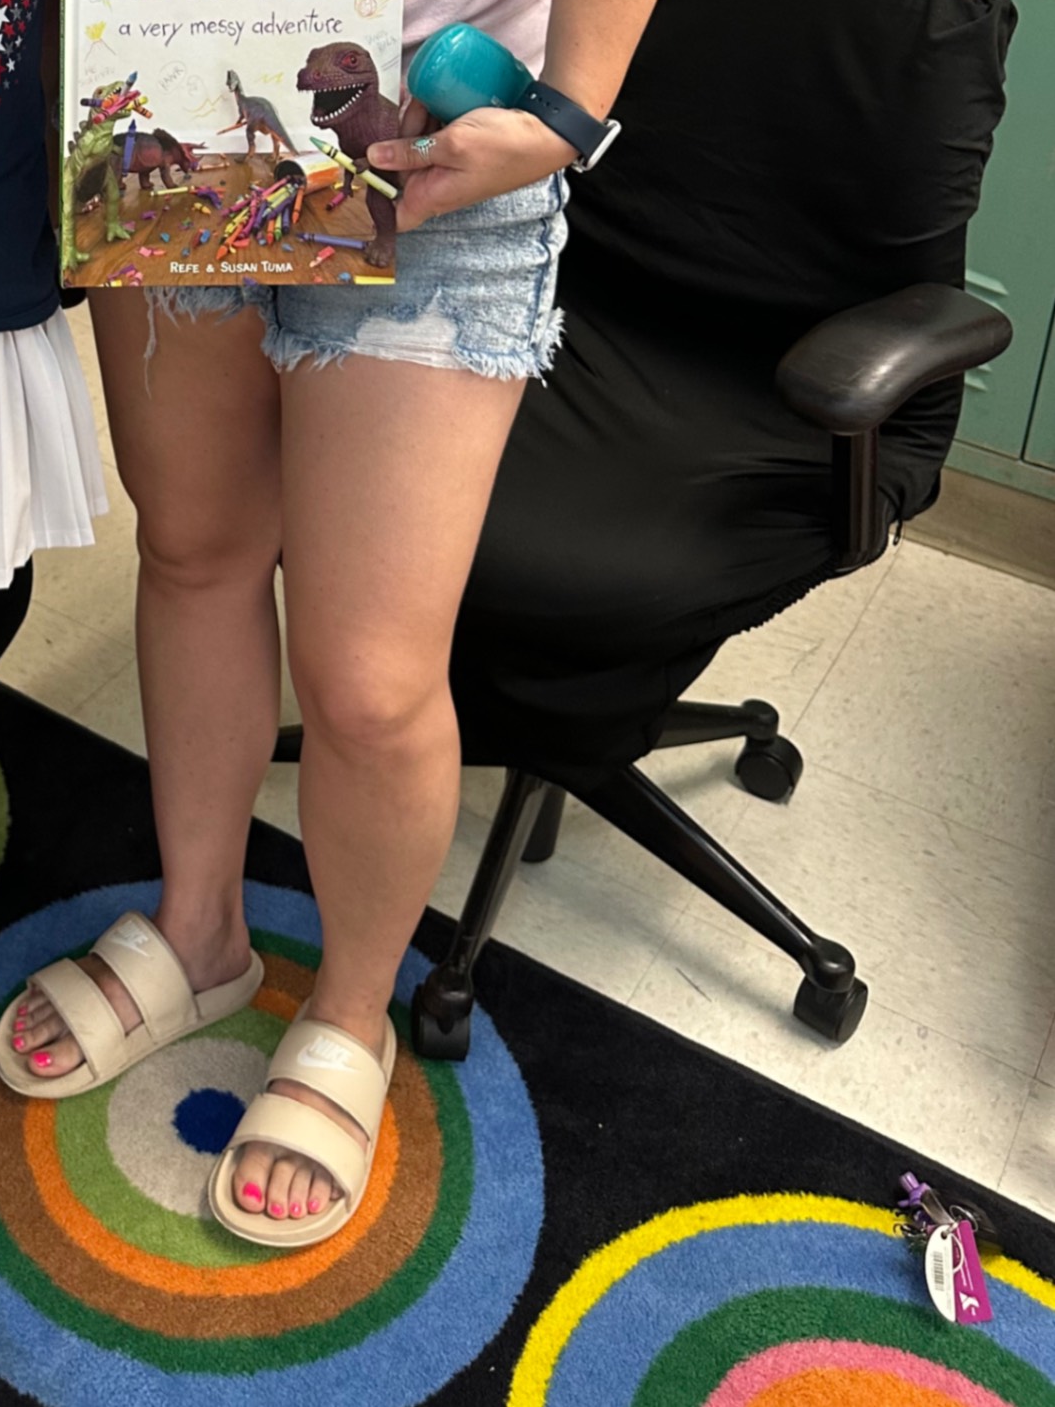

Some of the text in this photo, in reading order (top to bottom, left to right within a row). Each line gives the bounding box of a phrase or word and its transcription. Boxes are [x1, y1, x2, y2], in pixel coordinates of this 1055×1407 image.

[119, 9, 343, 47] a very messy adventure
[170, 261, 293, 274] REFE & SUSAN TUMA
